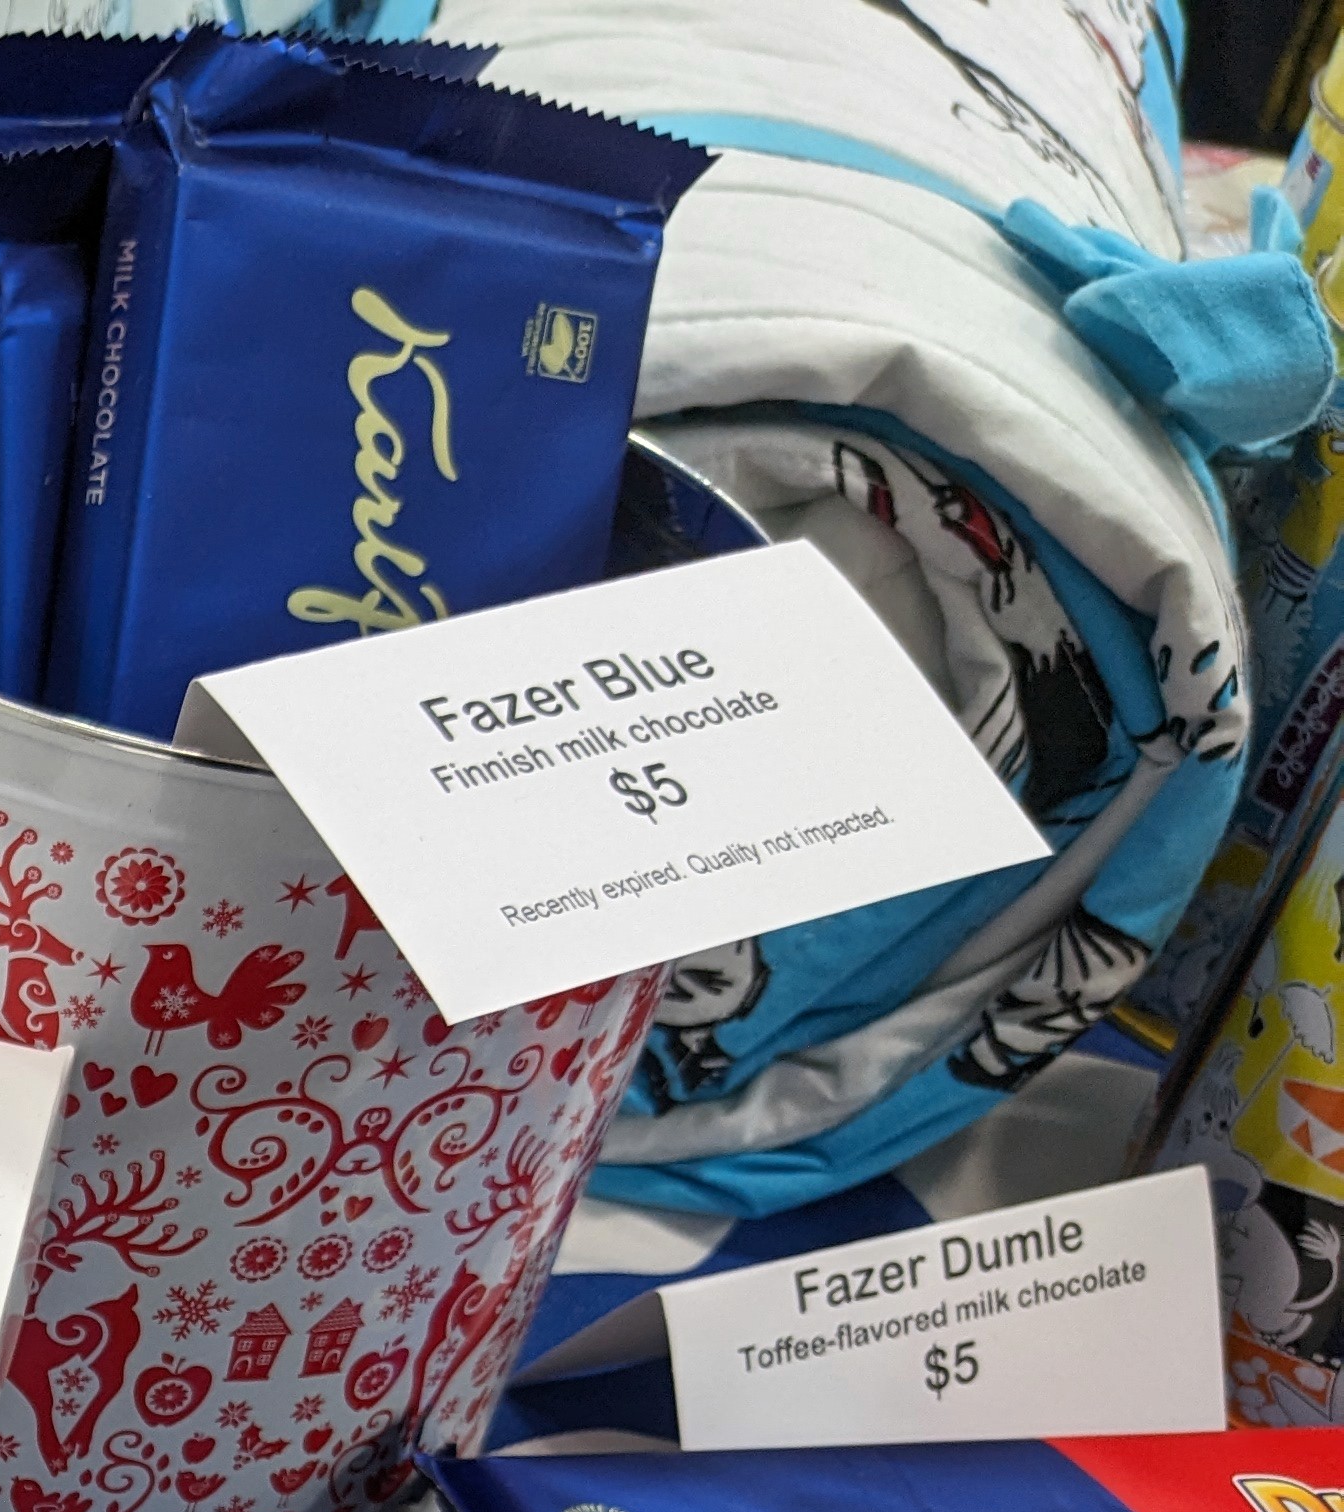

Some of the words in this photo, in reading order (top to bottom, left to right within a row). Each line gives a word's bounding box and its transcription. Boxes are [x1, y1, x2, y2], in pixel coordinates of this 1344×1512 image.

[110, 239, 139, 313] MILK
[84, 321, 127, 507] CHOCOLATE
[418, 678, 581, 743] Fazer
[581, 649, 716, 702] Blue
[429, 744, 556, 794] Finnish
[554, 725, 628, 763] milk
[627, 690, 779, 744] chocolate
[608, 762, 689, 826] $5
[499, 886, 600, 928] Recently
[601, 861, 688, 900] expired.
[686, 842, 762, 875] Quality
[761, 830, 801, 856] not
[793, 805, 895, 846] impacted.
[794, 1254, 927, 1315] Fazer
[940, 1215, 1085, 1281] Dumle
[736, 1300, 949, 1373] Toffee-flavored
[954, 1288, 1011, 1323] milk
[1017, 1260, 1148, 1309] chocolate
[923, 1339, 980, 1402] $5
